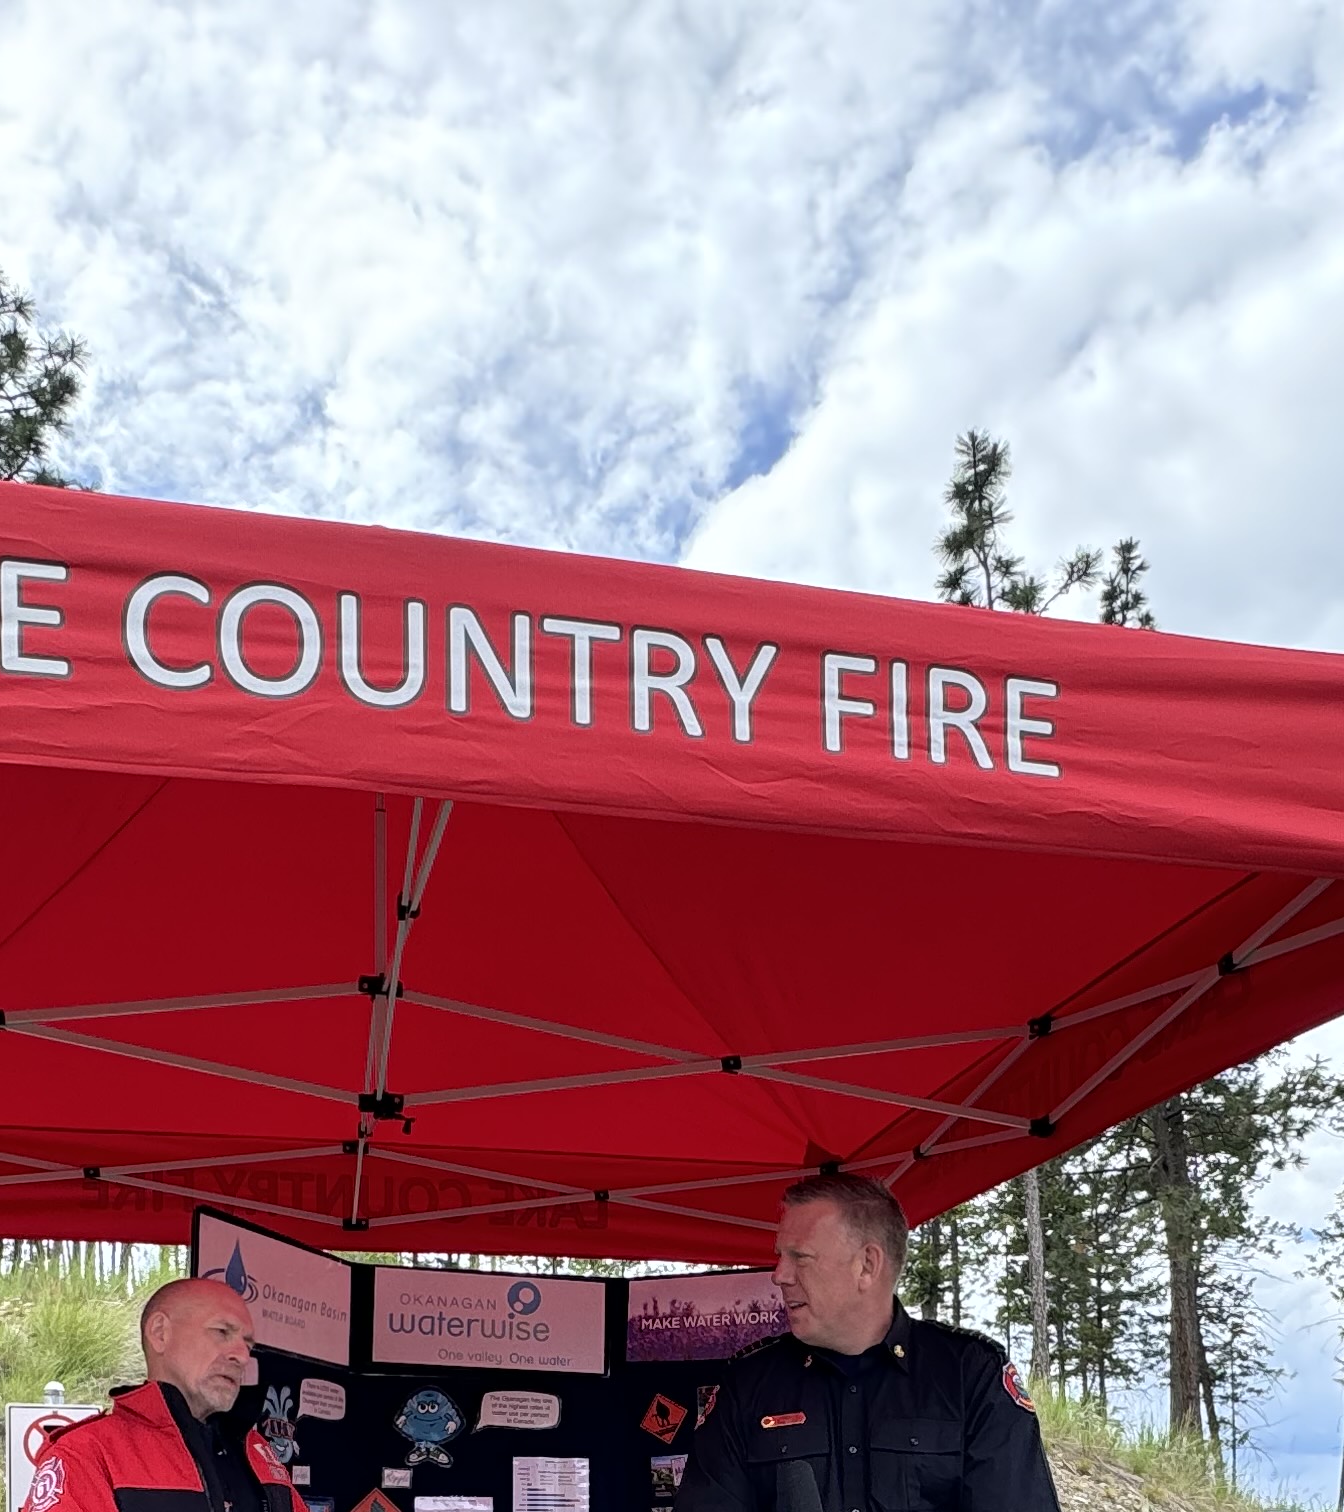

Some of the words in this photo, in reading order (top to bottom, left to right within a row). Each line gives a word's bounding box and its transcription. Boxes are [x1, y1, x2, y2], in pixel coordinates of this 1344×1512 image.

[125, 571, 778, 743] COUNTRY
[822, 650, 1062, 778] FIRE
[262, 1283, 318, 1314] Okanagan
[320, 1301, 348, 1323] Basin
[399, 1292, 498, 1311] OKANAGAN
[261, 1308, 284, 1324] WATER
[284, 1314, 306, 1329] BOARD
[388, 1311, 550, 1343] waterwise
[641, 1316, 681, 1331] MAKE
[683, 1314, 731, 1329] WATER
[733, 1310, 781, 1325] WORK
[437, 1348, 464, 1361] One
[509, 1352, 534, 1365] One
